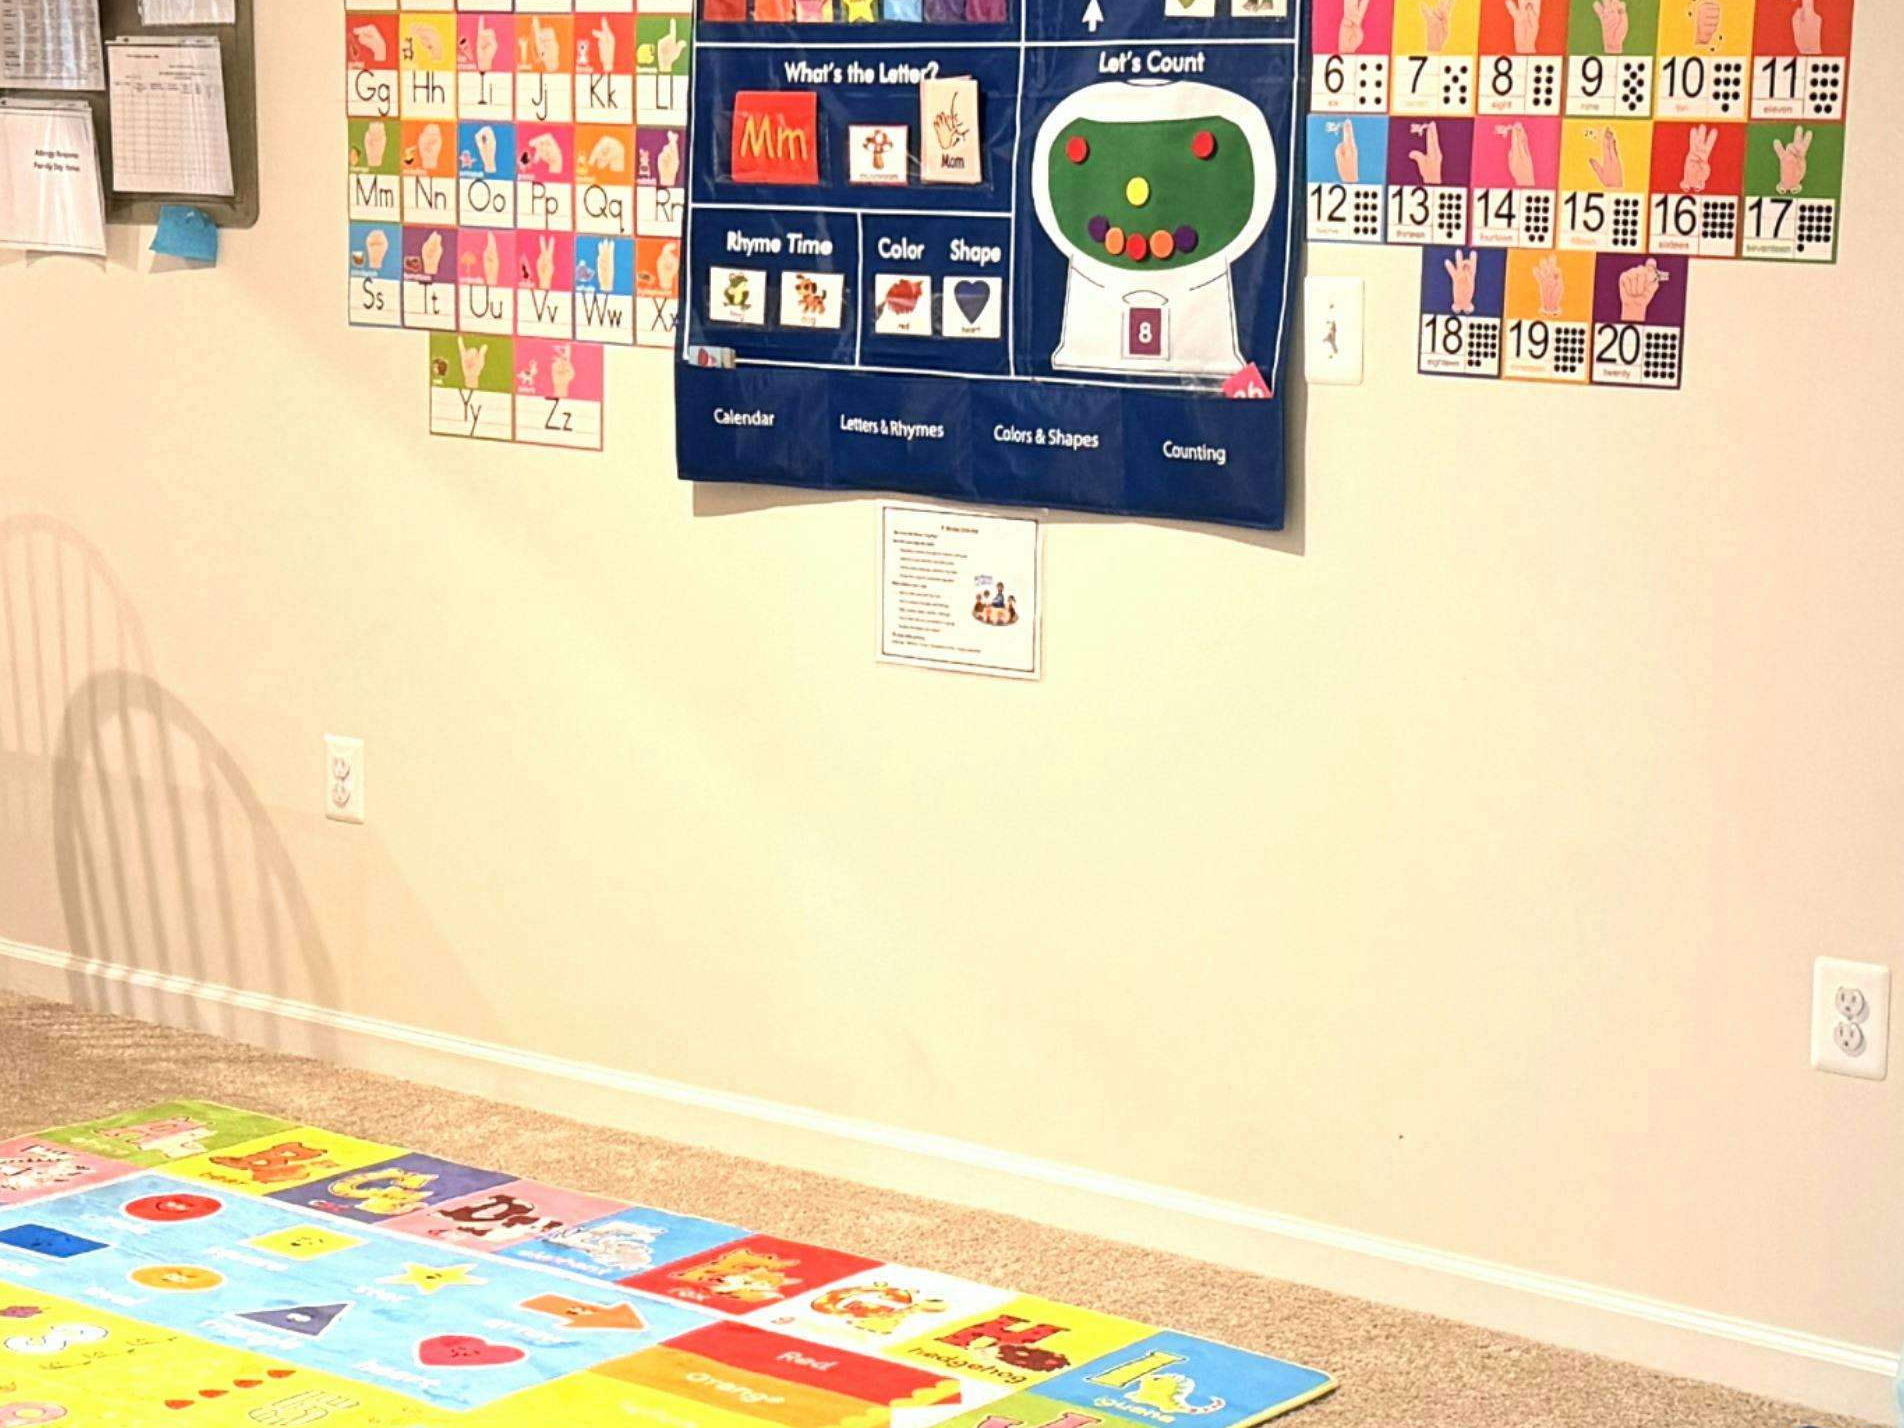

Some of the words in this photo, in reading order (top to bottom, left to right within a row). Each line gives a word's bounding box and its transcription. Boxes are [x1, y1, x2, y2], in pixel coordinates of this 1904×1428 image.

[784, 60, 843, 84] What's
[847, 60, 875, 84] the
[879, 60, 940, 84] Letter?
[1098, 50, 1142, 75] Let's
[1146, 49, 1206, 74] Count
[1324, 55, 1345, 93] 6
[1408, 56, 1428, 95] 7
[1491, 56, 1513, 97] 8
[1581, 56, 1603, 97] 9
[1662, 57, 1705, 99] 10
[1761, 58, 1798, 99] 11
[354, 69, 391, 117] Gg
[412, 71, 446, 104] Hh
[531, 73, 548, 122] Jj
[590, 73, 619, 110] Kk
[739, 115, 808, 161] Mm
[941, 153, 965, 169] Mom
[355, 177, 395, 210] Mm
[414, 178, 448, 211] Nn
[467, 178, 507, 214] Oo
[531, 180, 560, 224] Pp
[583, 183, 625, 234] Qq
[1310, 184, 1347, 222] 12
[1391, 186, 1431, 226] 13
[1477, 188, 1517, 229] 14
[1563, 191, 1606, 232] 15
[1653, 194, 1697, 237] 16
[1747, 197, 1793, 239] 17
[726, 230, 782, 257] Rhyme
[786, 232, 834, 256] Time
[877, 237, 925, 261] Color
[949, 239, 1002, 267] Shape
[361, 277, 385, 311] Ss
[417, 281, 441, 316] Tt
[469, 284, 504, 320] Uu
[530, 288, 559, 323] Vv
[582, 292, 624, 328] Ww
[1138, 321, 1154, 345] 8
[1424, 316, 1463, 356] 18
[1508, 319, 1550, 360] 19
[1595, 324, 1642, 366] 20
[458, 388, 483, 437] Yy
[543, 396, 574, 432] Zz
[713, 408, 775, 427] Calendar
[840, 414, 879, 435] Letters
[880, 418, 889, 435] &
[890, 420, 945, 441] Rhymes
[994, 424, 1033, 447] Colors
[1035, 428, 1047, 446] &
[1048, 429, 1100, 453] Shapes
[1162, 440, 1227, 466] Counting
[775, 1351, 840, 1373] Red
[906, 1346, 1029, 1384] hedgehog
[684, 1370, 787, 1405] Orange
[1093, 1394, 1176, 1425] iguana
